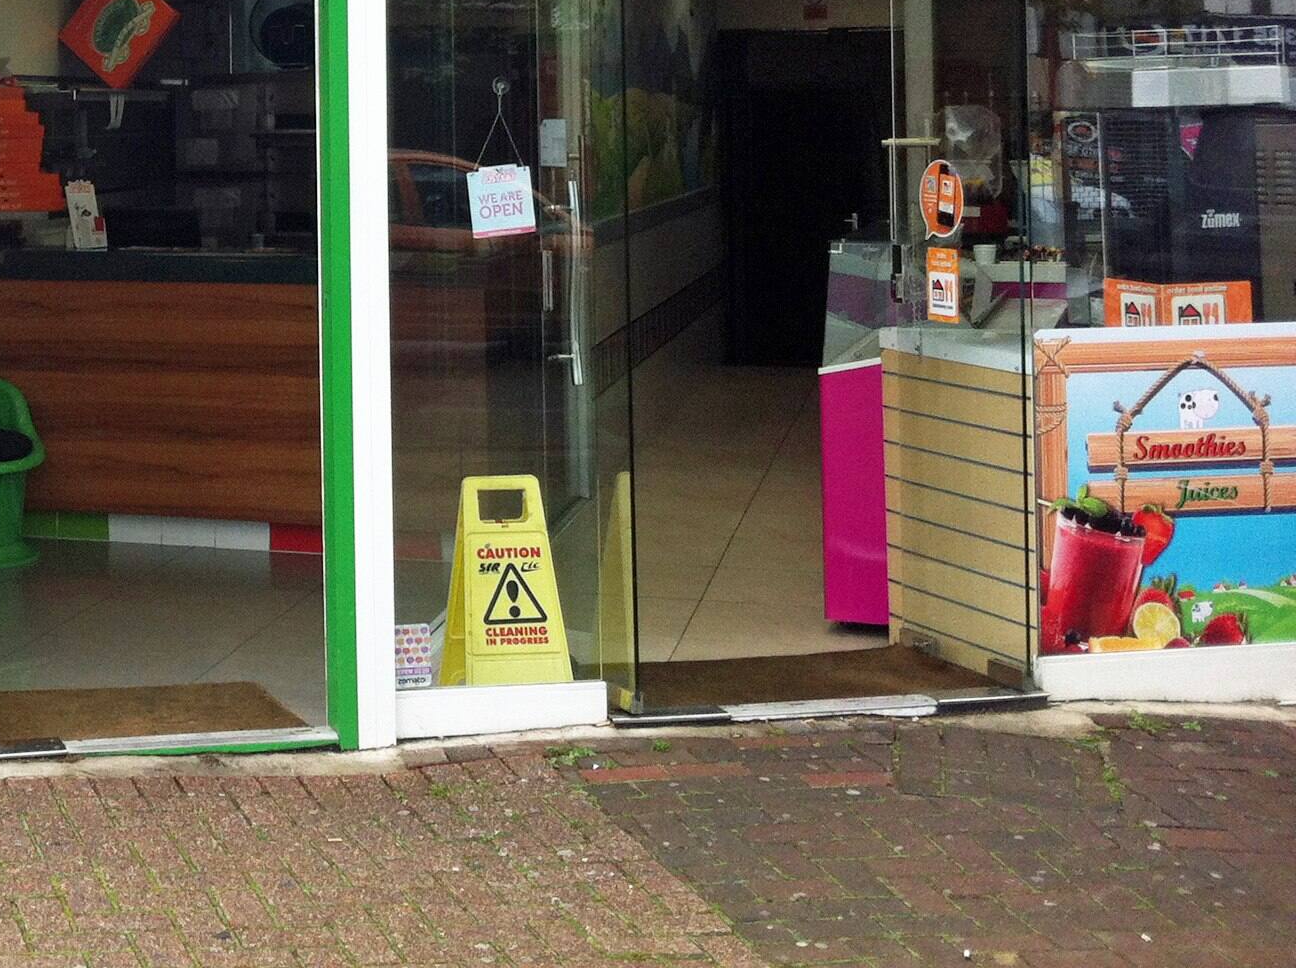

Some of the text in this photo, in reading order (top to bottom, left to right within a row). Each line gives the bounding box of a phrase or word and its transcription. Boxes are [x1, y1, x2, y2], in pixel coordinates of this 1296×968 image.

[479, 190, 523, 205] WE ARE
[479, 201, 524, 219] OPEN
[1133, 433, 1247, 461] Smoothies
[1175, 479, 1239, 509] Juices
[477, 547, 541, 559] CAUTION
[485, 626, 548, 637] CLEANING
[486, 637, 549, 646] IN PROGRESS
